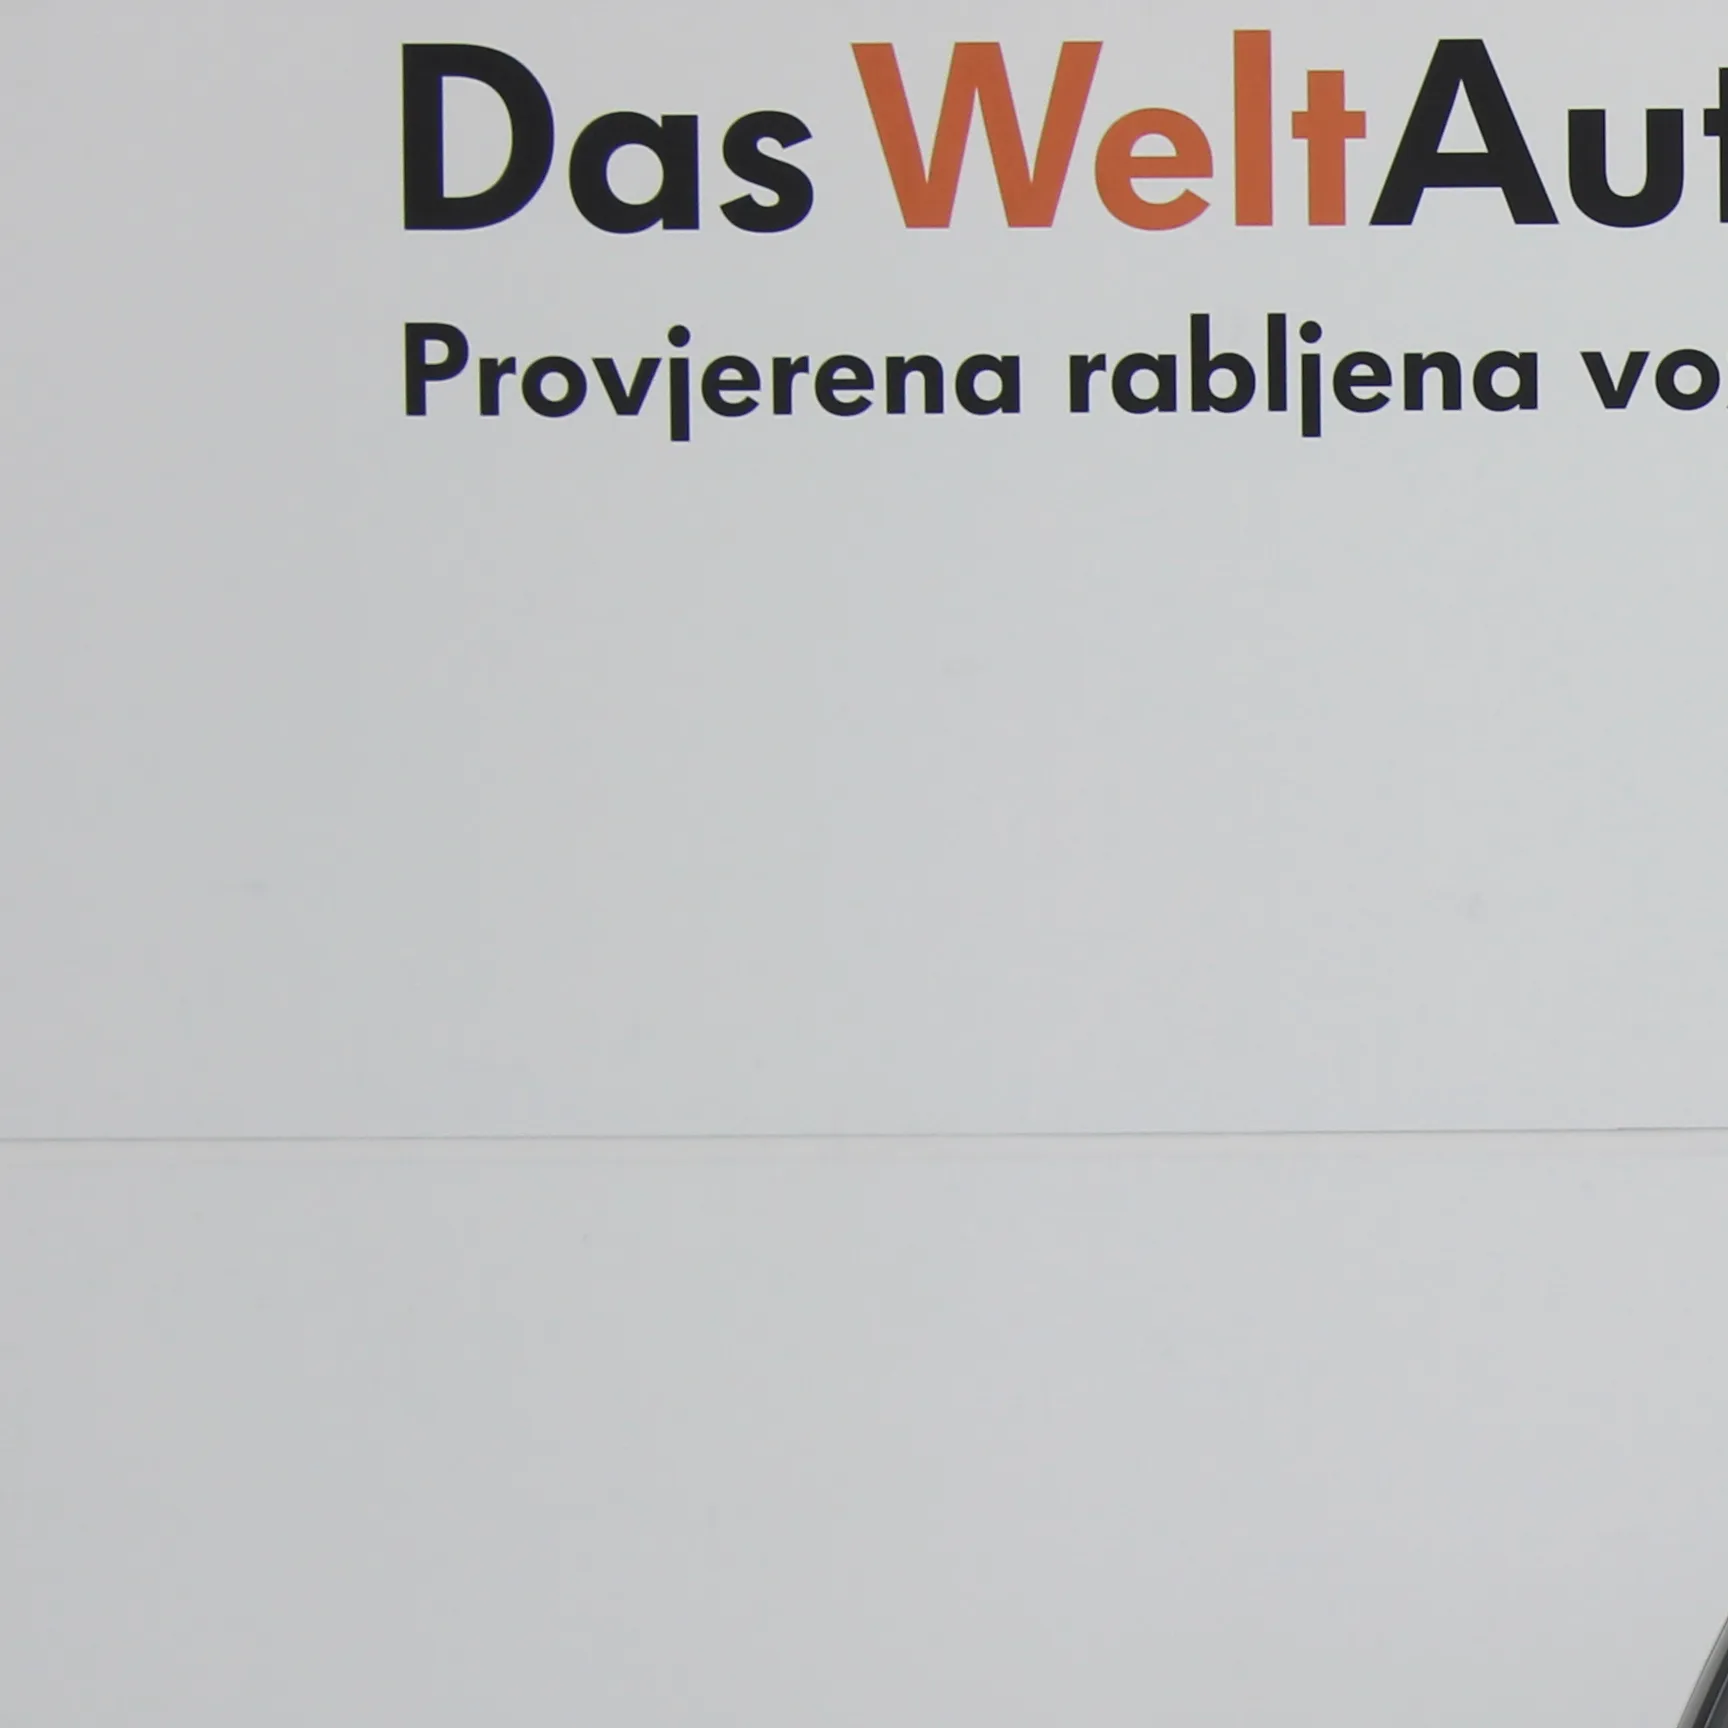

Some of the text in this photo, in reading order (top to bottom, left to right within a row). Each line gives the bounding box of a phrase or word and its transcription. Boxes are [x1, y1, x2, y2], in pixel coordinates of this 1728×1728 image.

[400, 42, 814, 235] Das
[404, 322, 1021, 442] Provjerena
[1068, 312, 1538, 438] rabljena
